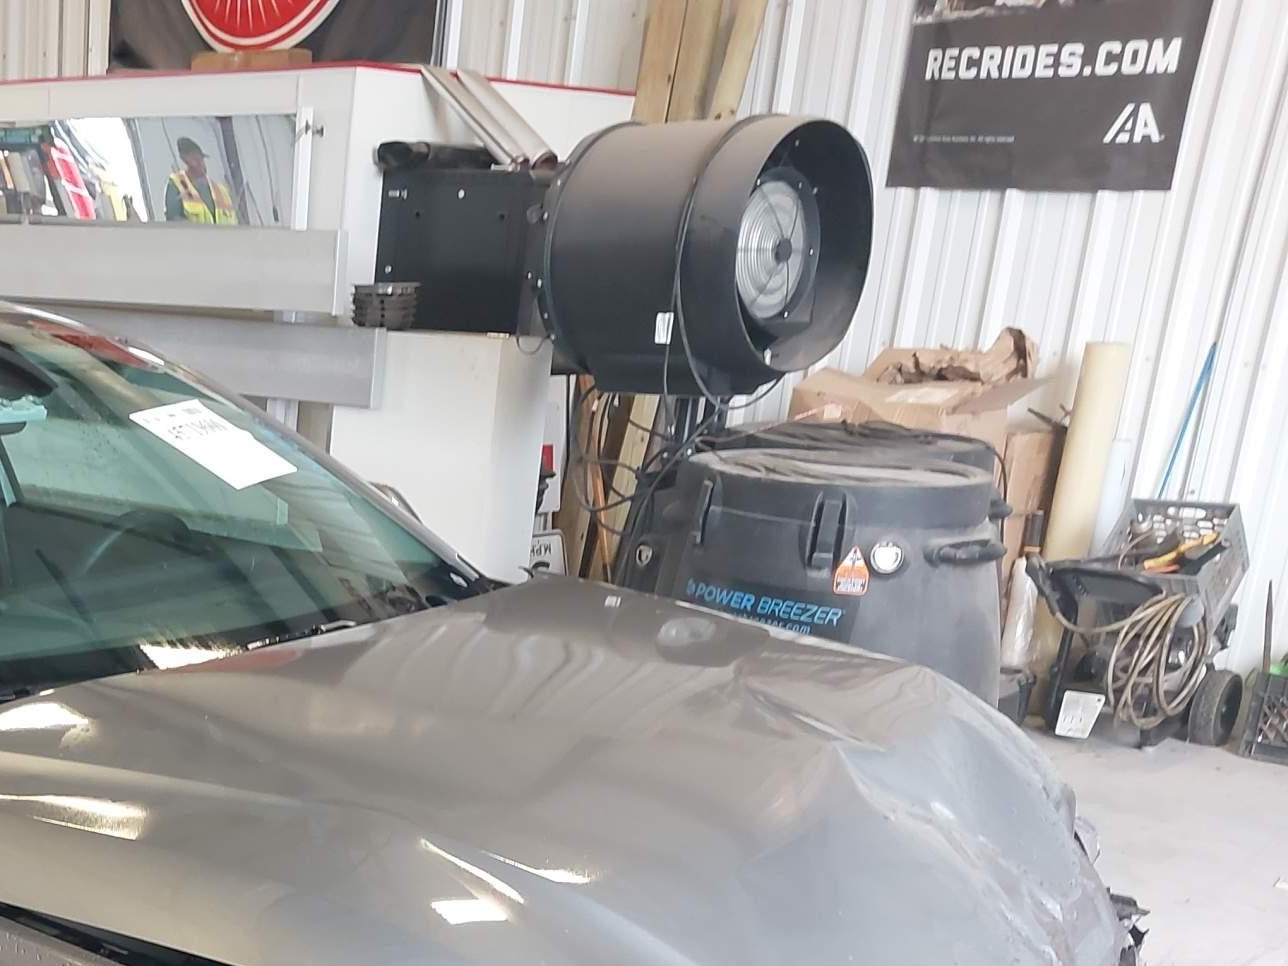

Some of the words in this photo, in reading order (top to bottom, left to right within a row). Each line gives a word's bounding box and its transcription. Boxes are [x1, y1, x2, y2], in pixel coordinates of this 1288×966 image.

[925, 37, 1183, 81] RECRIDES.COM
[696, 582, 755, 612] POWER
[757, 596, 842, 627] BREEZER
